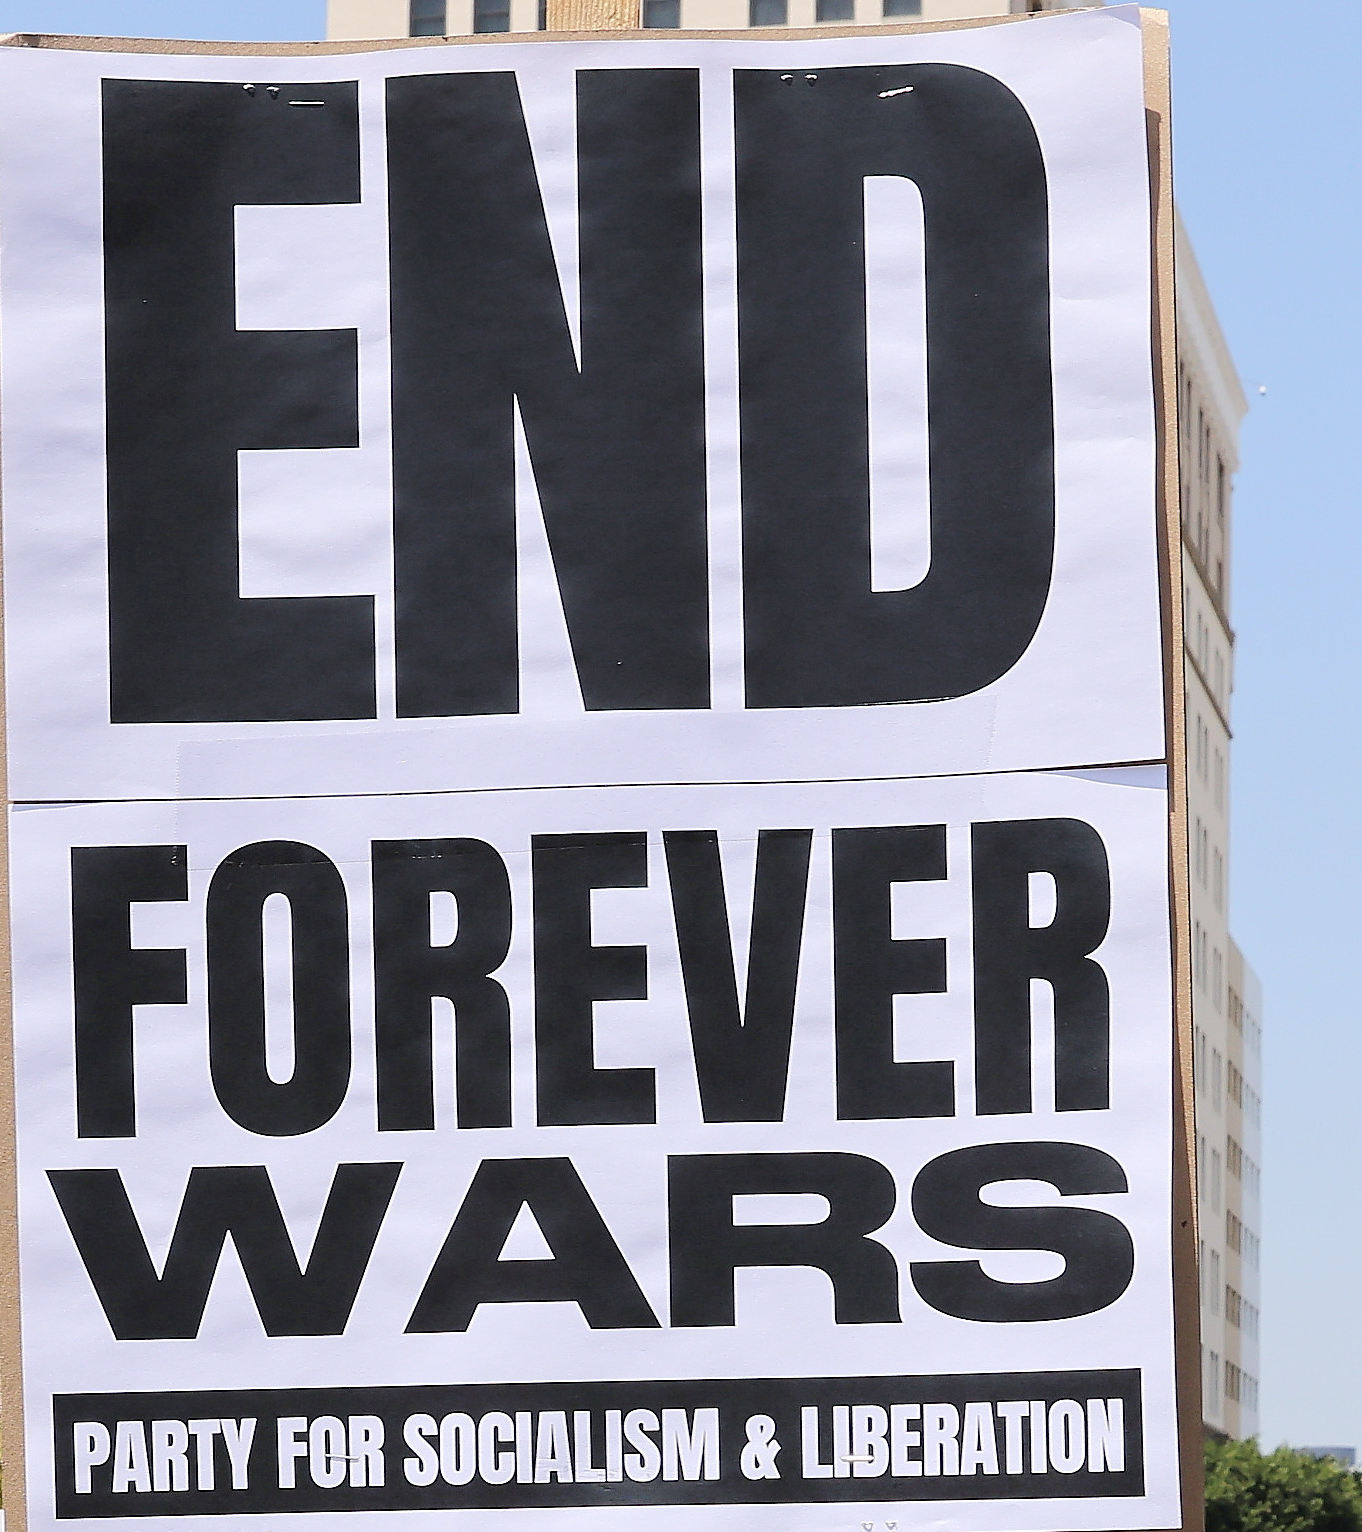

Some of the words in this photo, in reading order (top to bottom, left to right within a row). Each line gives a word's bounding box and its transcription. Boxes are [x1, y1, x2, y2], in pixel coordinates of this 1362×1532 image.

[101, 63, 1055, 723] END
[71, 817, 1111, 1138] FOREVER
[46, 1141, 1135, 1340] WARS
[74, 1417, 253, 1494] PARTY
[278, 1412, 385, 1490] FOR
[403, 1406, 721, 1486] SOCIALISM
[741, 1408, 782, 1480] &
[803, 1397, 1126, 1481] LIBERATION
